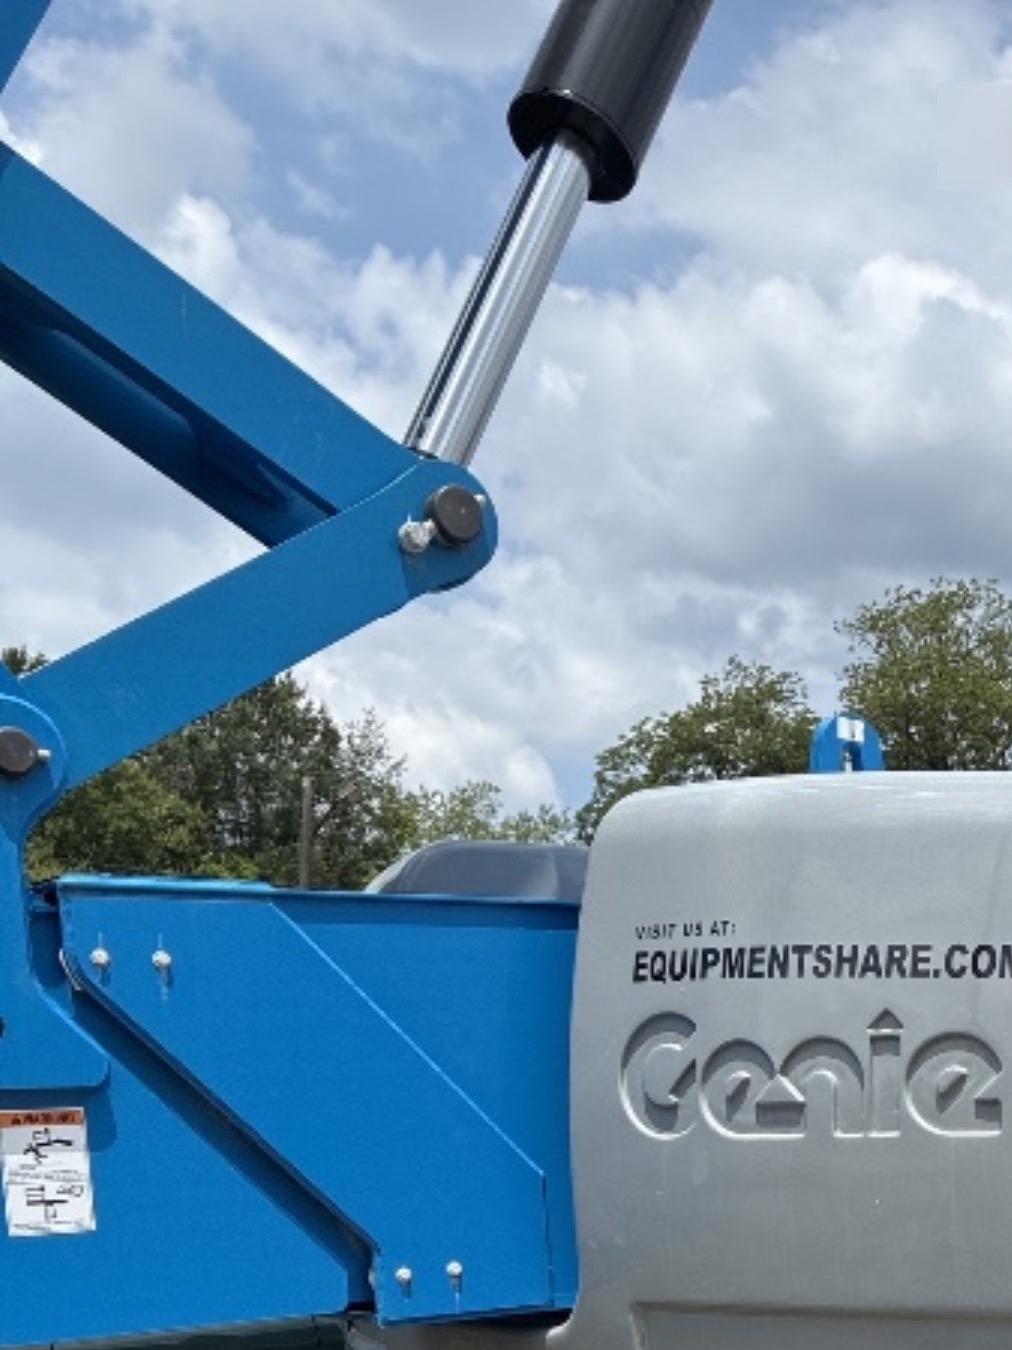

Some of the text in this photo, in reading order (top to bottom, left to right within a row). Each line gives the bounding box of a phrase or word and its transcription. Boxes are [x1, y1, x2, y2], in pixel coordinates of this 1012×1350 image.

[635, 920, 736, 939] VISIT US AT:
[620, 1007, 1002, 1141] Genie
